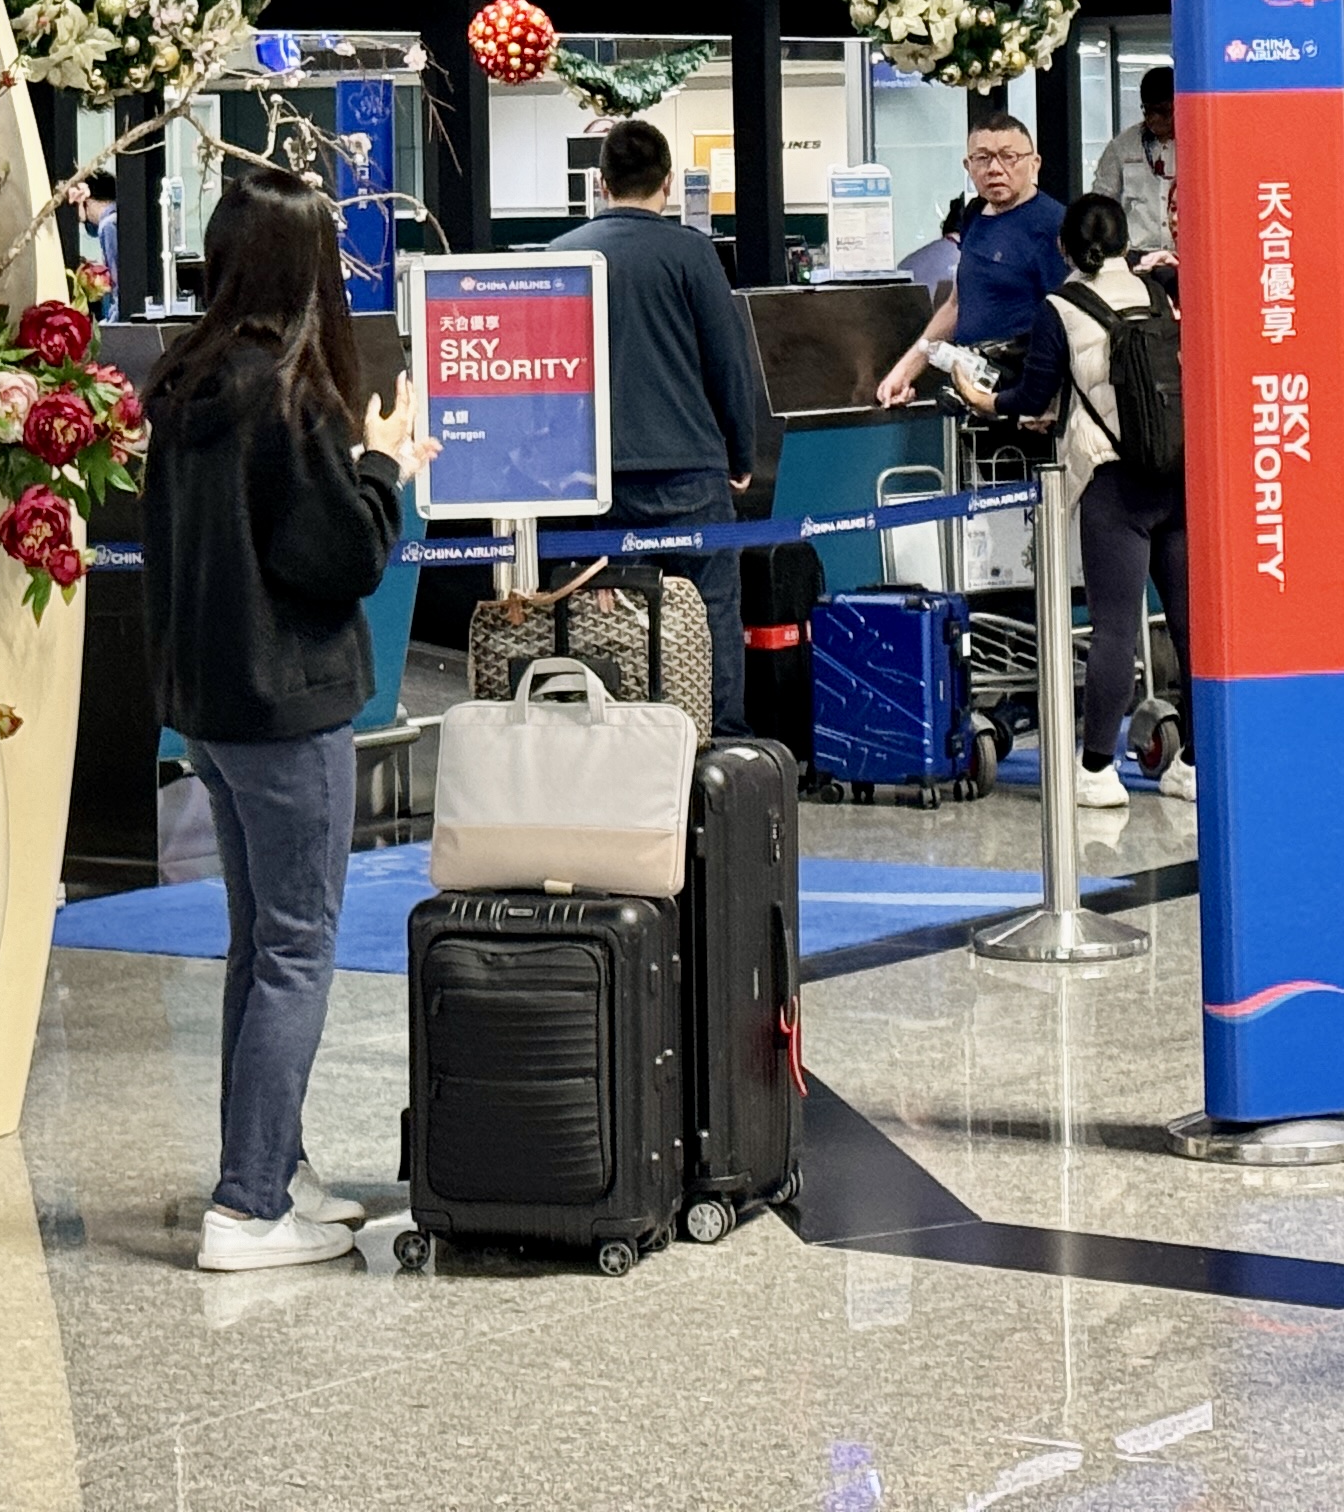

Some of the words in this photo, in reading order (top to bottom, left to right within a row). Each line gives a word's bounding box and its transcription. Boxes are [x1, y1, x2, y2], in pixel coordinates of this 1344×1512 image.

[1252, 39, 1292, 50] CHINA
[1246, 49, 1300, 62] AIRLINES
[1257, 182, 1297, 344] 天合優享
[476, 280, 507, 291] CHINA
[509, 279, 552, 291] AIRLINES
[440, 338, 500, 360] SKY
[440, 358, 579, 383] PRIORITY
[1281, 374, 1311, 463] SKY
[442, 430, 486, 441] Paragon
[1252, 374, 1285, 584] PRIORITY
[111, 552, 144, 565] CHIN
[424, 547, 463, 560] CHINA
[464, 545, 515, 559] AIRLINES
